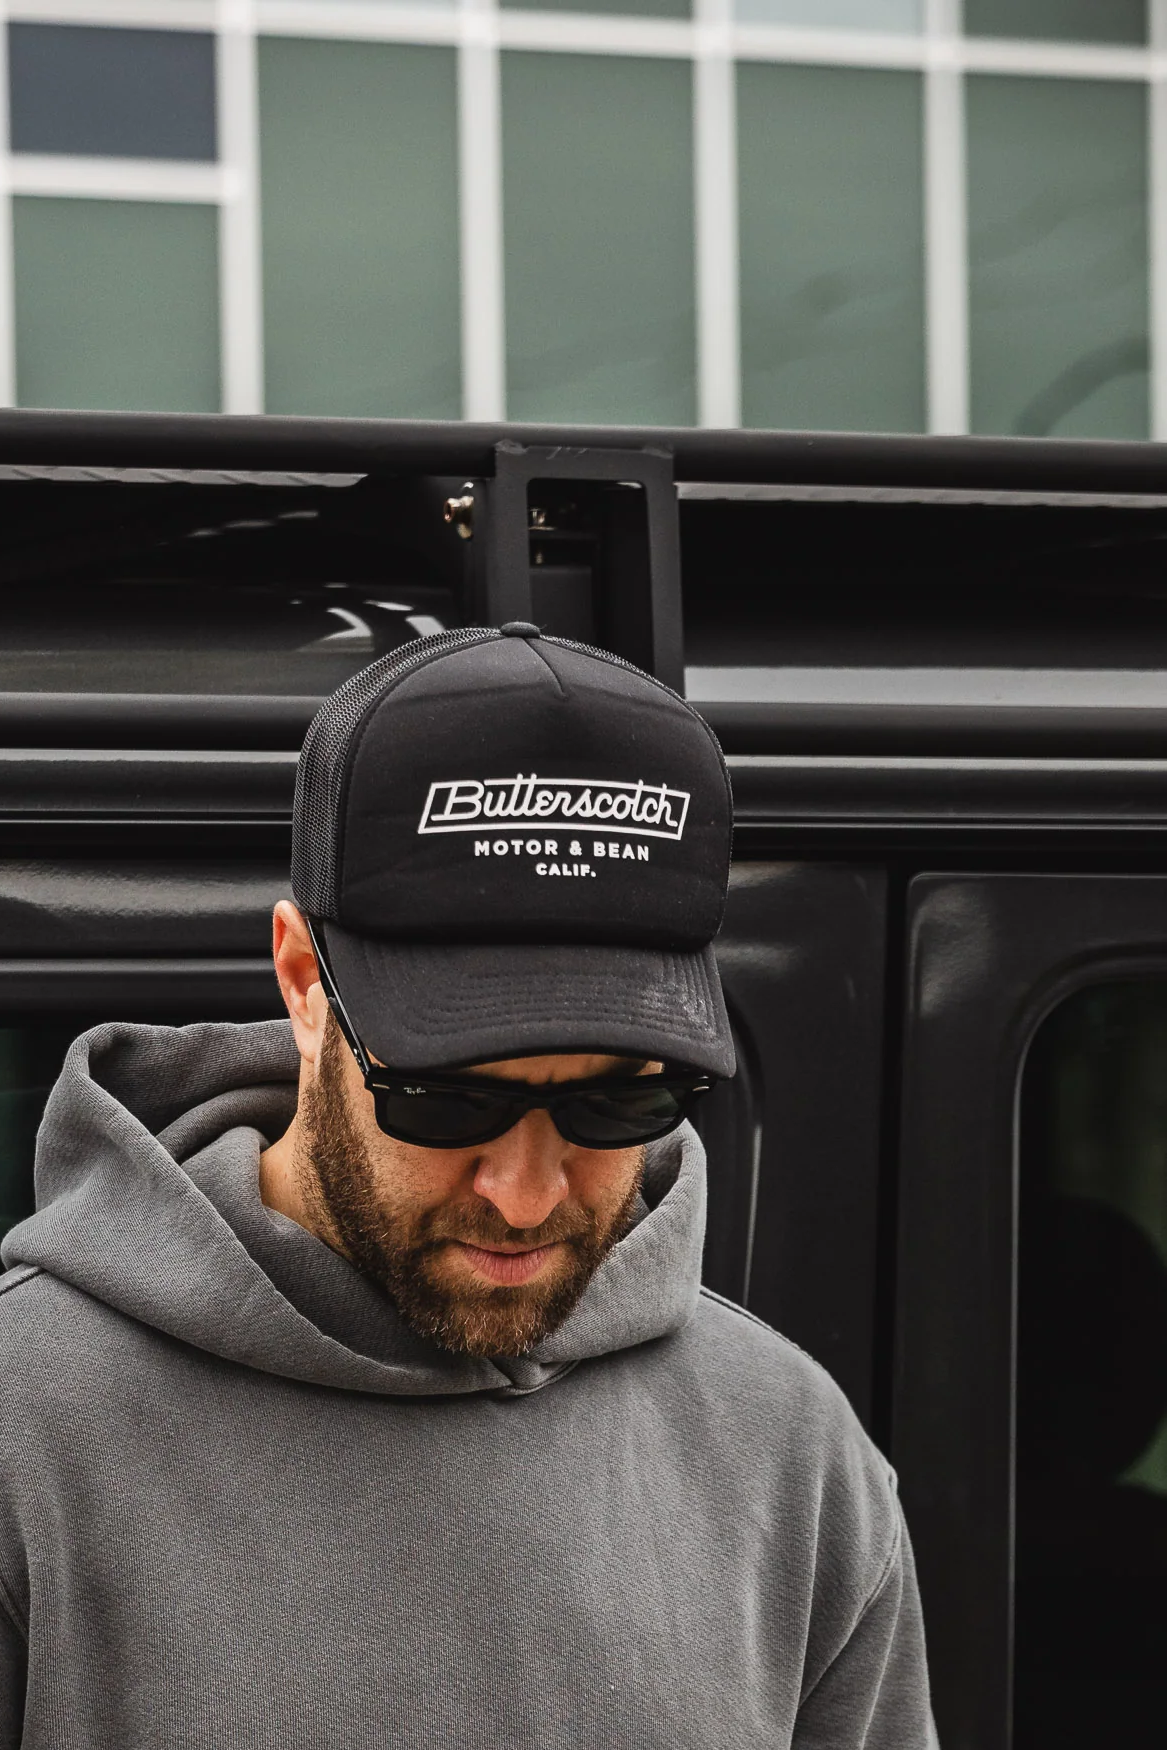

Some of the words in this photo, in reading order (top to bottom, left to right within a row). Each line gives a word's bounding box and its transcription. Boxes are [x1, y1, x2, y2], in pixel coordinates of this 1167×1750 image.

[431, 773, 679, 827] Butterscotch
[474, 839, 559, 856] MOTOR
[569, 840, 583, 856] &
[593, 842, 649, 862] BEAN
[535, 862, 597, 878] CALIF.
